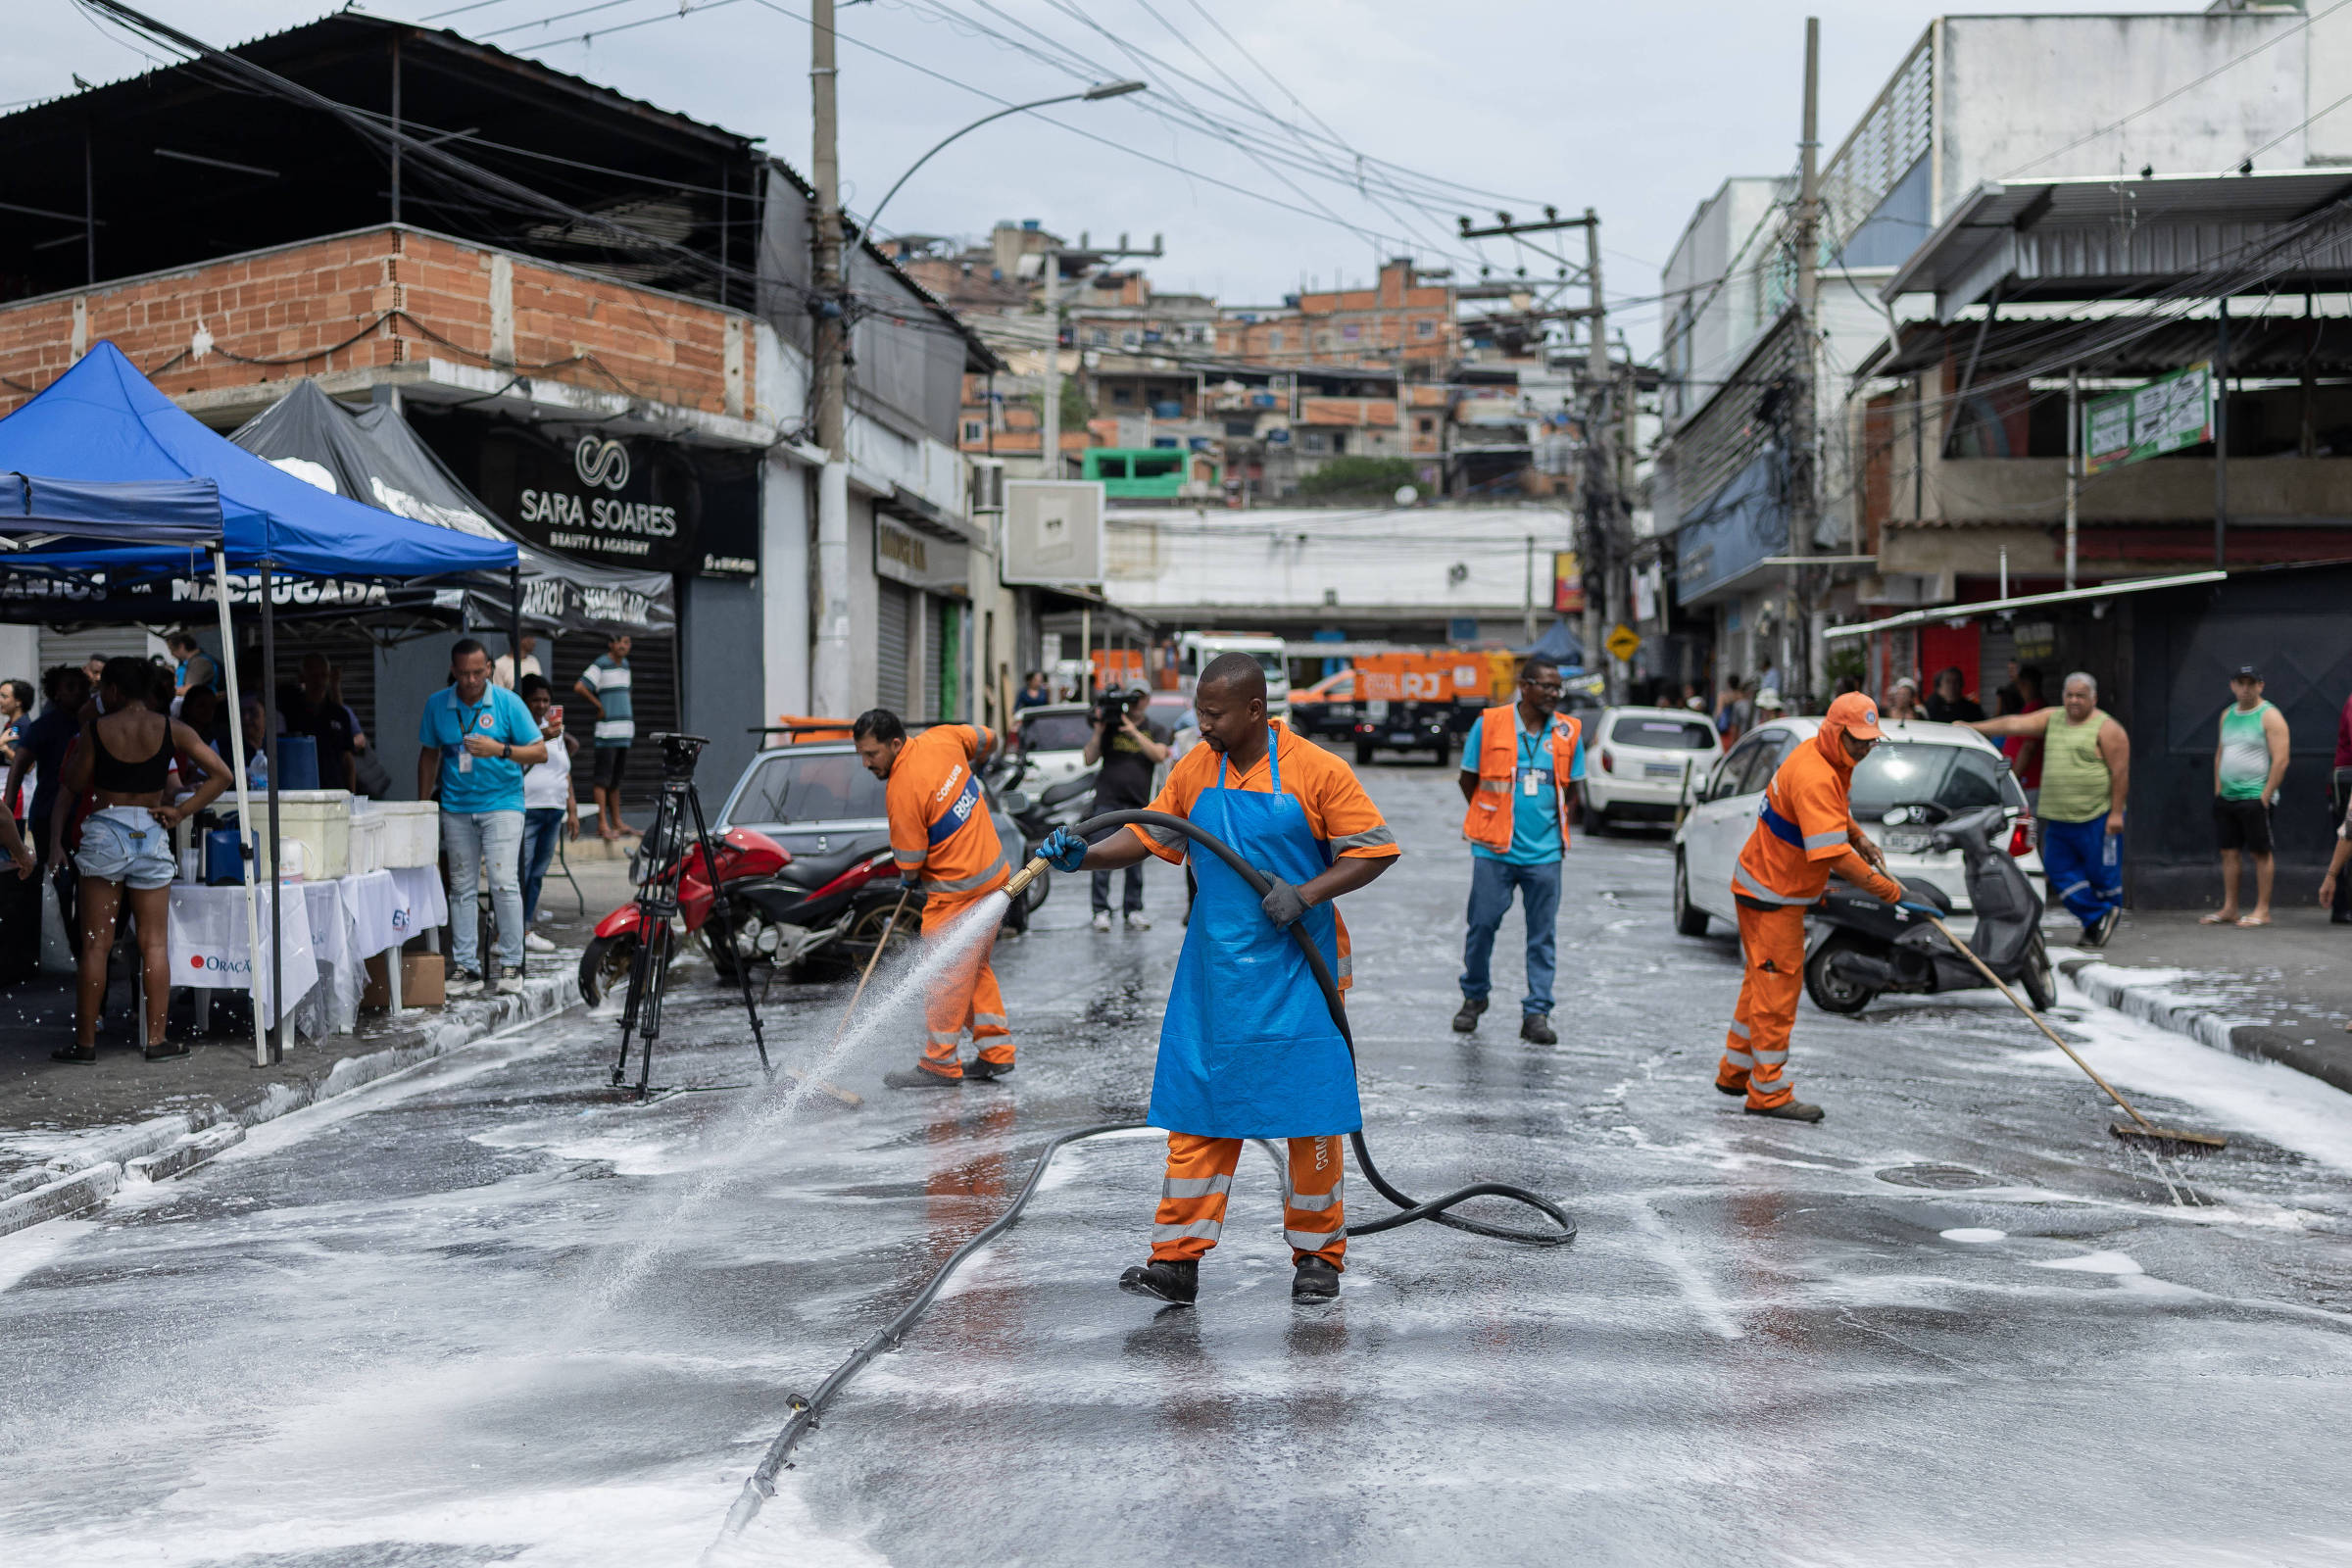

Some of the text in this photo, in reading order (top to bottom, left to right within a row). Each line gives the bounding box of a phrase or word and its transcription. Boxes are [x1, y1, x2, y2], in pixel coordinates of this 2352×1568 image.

[520, 489, 677, 537] SARA SOARES
[550, 531, 590, 550] BEAUTY
[602, 538, 651, 556] ACADEMY
[521, 580, 565, 616] ANJOS
[1401, 672, 1440, 699] RJ
[206, 956, 252, 974] ORAÇÃ
